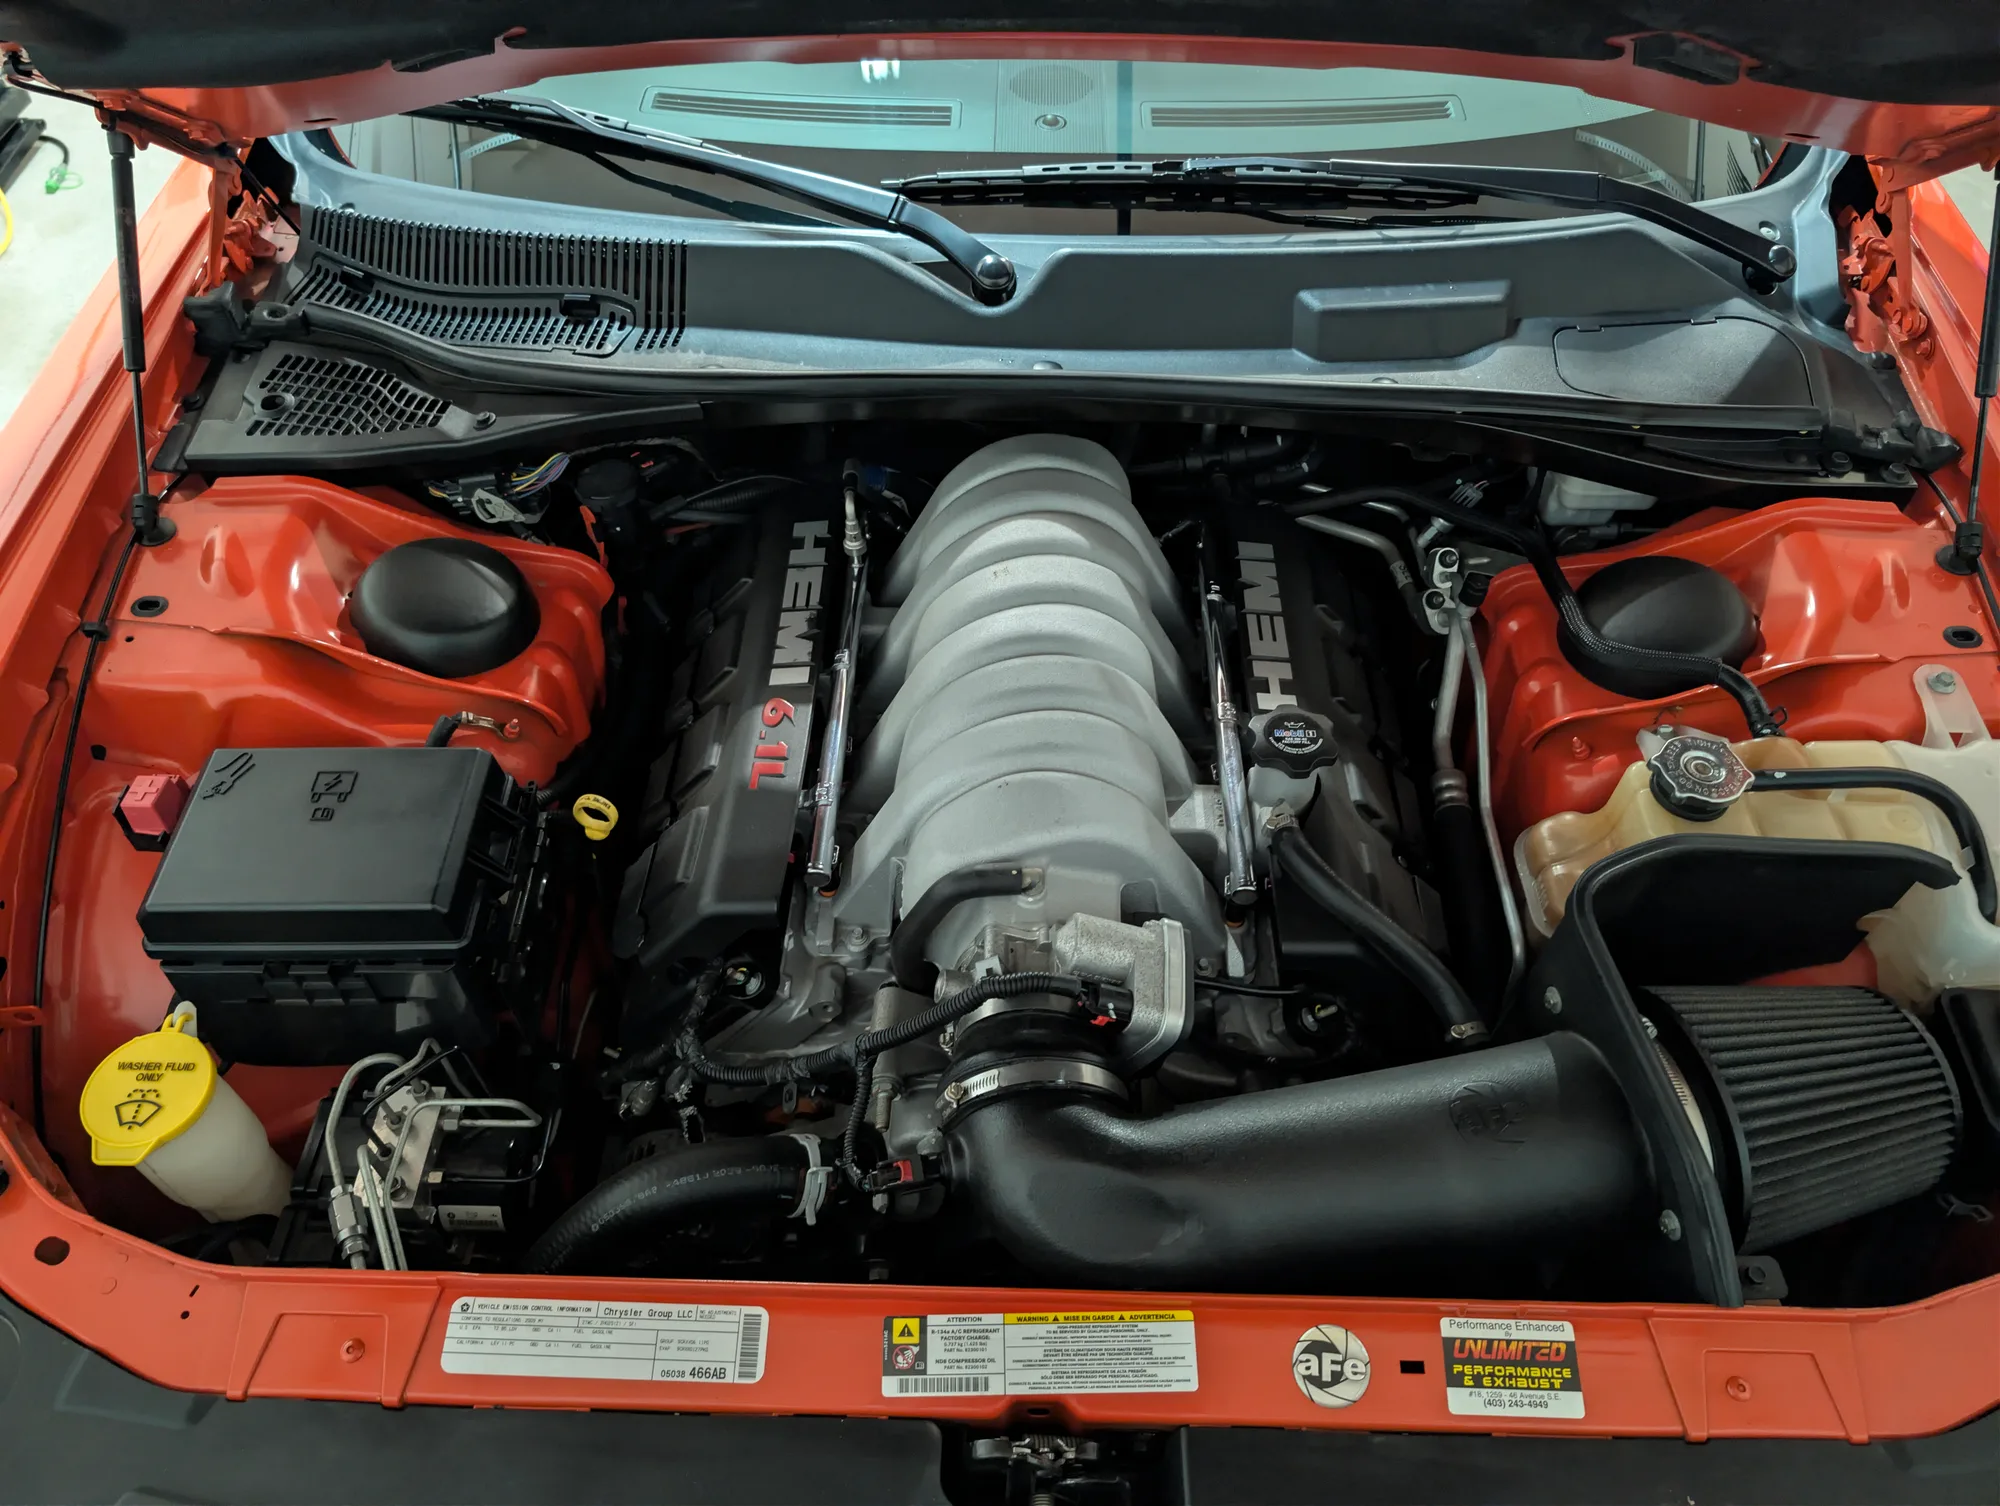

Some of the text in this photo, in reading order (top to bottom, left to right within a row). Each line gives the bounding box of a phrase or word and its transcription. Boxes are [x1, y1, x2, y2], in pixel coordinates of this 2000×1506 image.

[769, 520, 830, 686] HEMI
[1237, 541, 1298, 710] HEMI
[1274, 729, 1304, 737] Mobil
[748, 698, 795, 790] 6.1L
[118, 1062, 196, 1071] WASHER FLUID
[136, 1073, 164, 1081] ONLY
[604, 1307, 693, 1320] Chrysler Group LLC
[1449, 1319, 1565, 1332] Performance Enhanced
[1454, 1339, 1566, 1361] UNLIMITED
[660, 1367, 727, 1380] 05038 466AB
[1298, 1352, 1366, 1382] aFe
[1453, 1364, 1572, 1378] PERFORMANCE
[1464, 1376, 1563, 1389] & EXHAUST
[1484, 1399, 1548, 1409] (403) 243-4949
